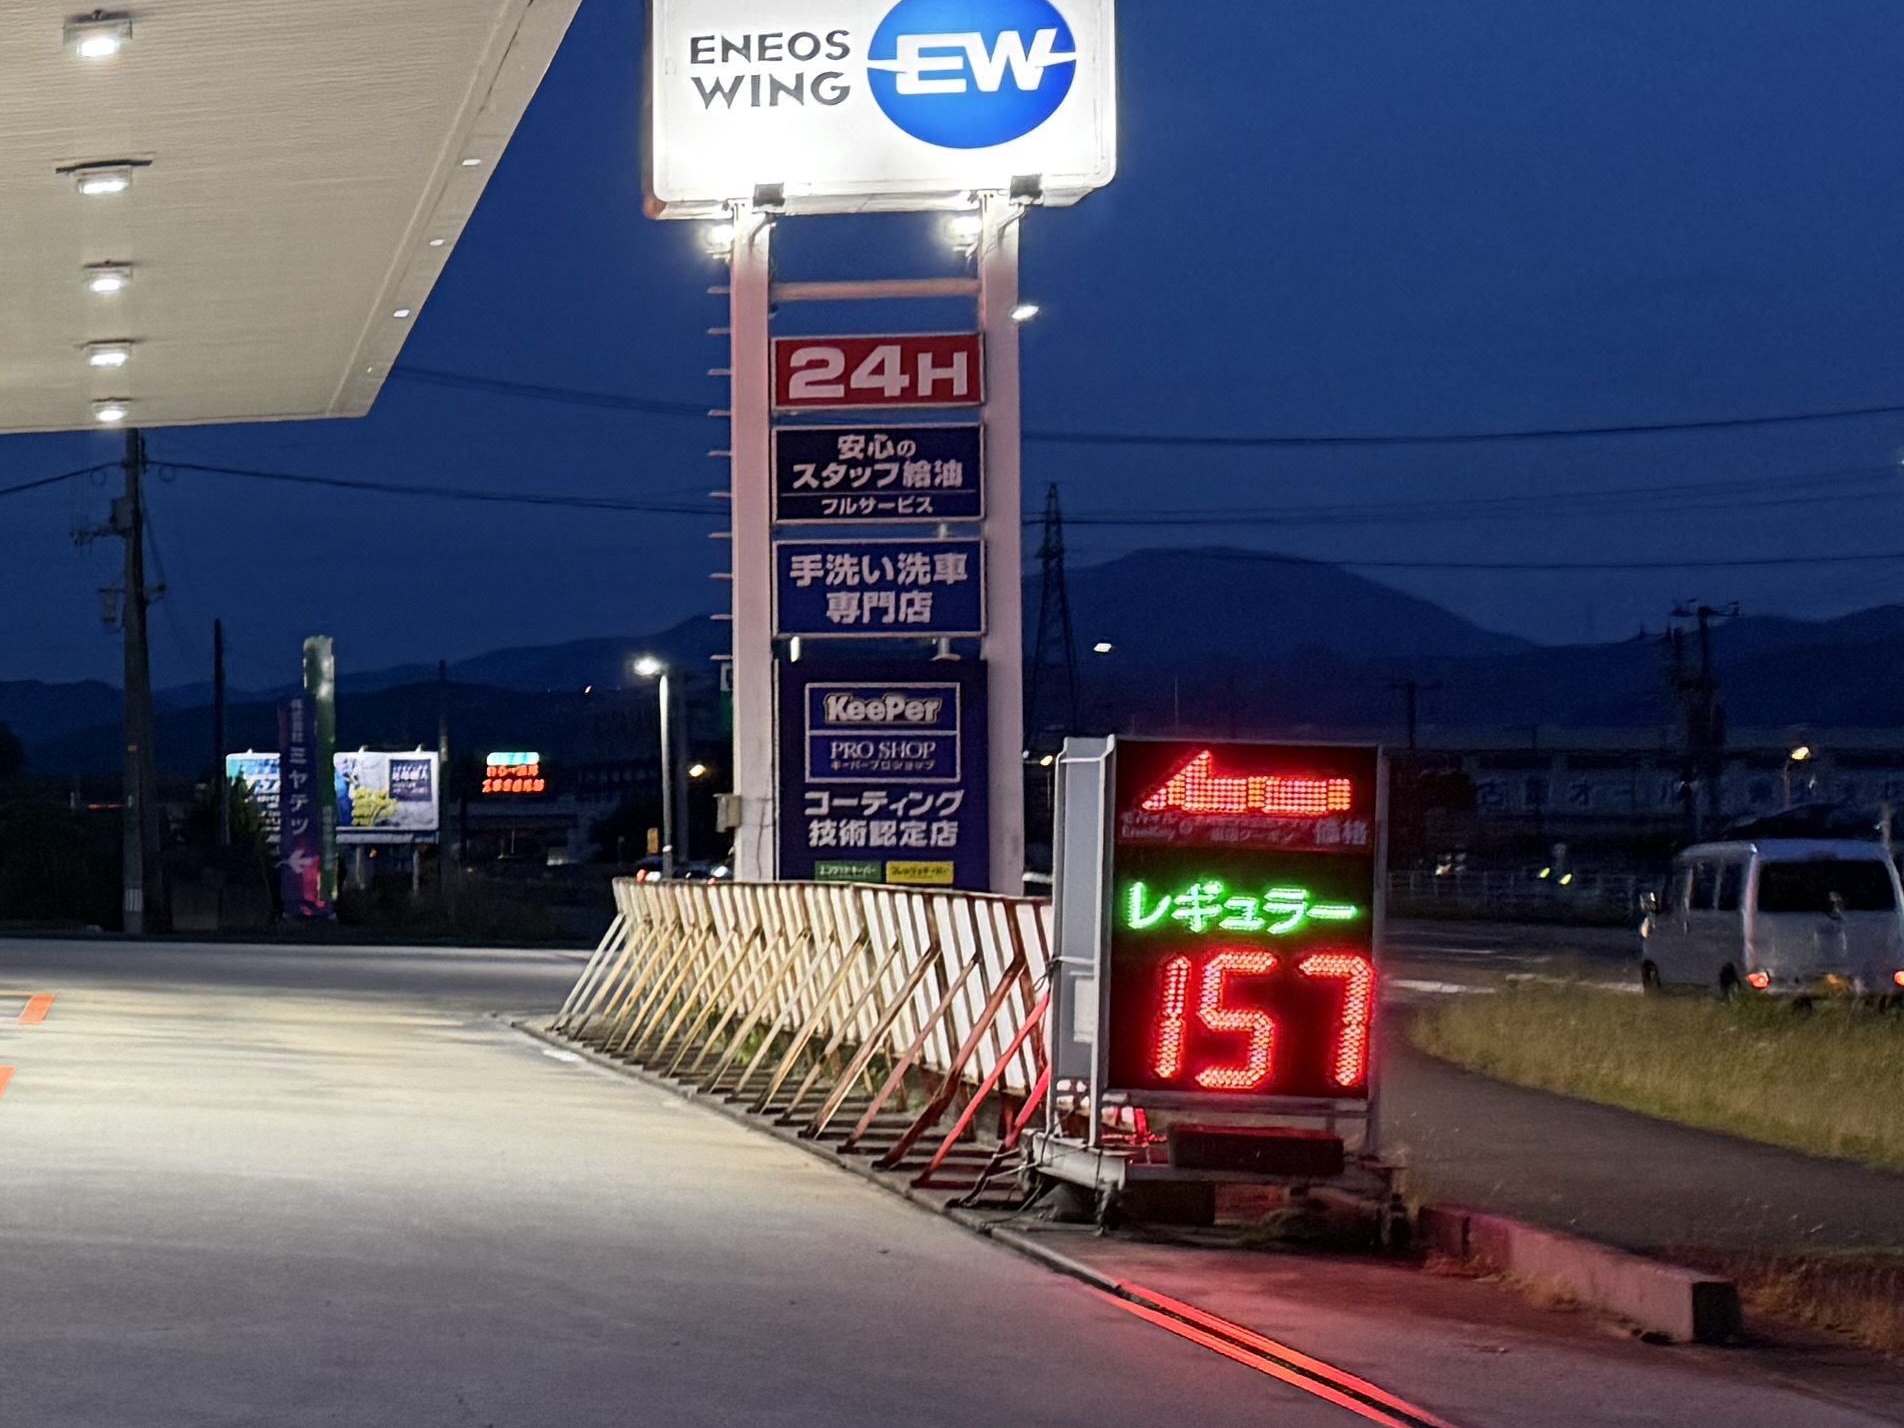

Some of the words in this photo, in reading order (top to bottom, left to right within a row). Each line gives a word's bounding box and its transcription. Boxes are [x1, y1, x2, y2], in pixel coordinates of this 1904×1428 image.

[690, 30, 851, 64] ENEOS
[895, 28, 1060, 95] EW
[690, 71, 851, 109] WING
[788, 345, 969, 400] 24H
[836, 434, 917, 460] 安心の
[792, 459, 964, 489] スタッフ給油
[820, 496, 934, 515] フルサービス
[789, 552, 969, 588] 手洗い洗車
[825, 591, 934, 625] 専門店
[823, 693, 943, 723] KeePer
[829, 741, 875, 759] PRO
[878, 741, 937, 759] SHOP
[803, 788, 965, 816] コーティング
[808, 818, 959, 847] 技術認定店
[1128, 880, 1358, 934] レギュラー
[1154, 950, 1374, 1090] 157
